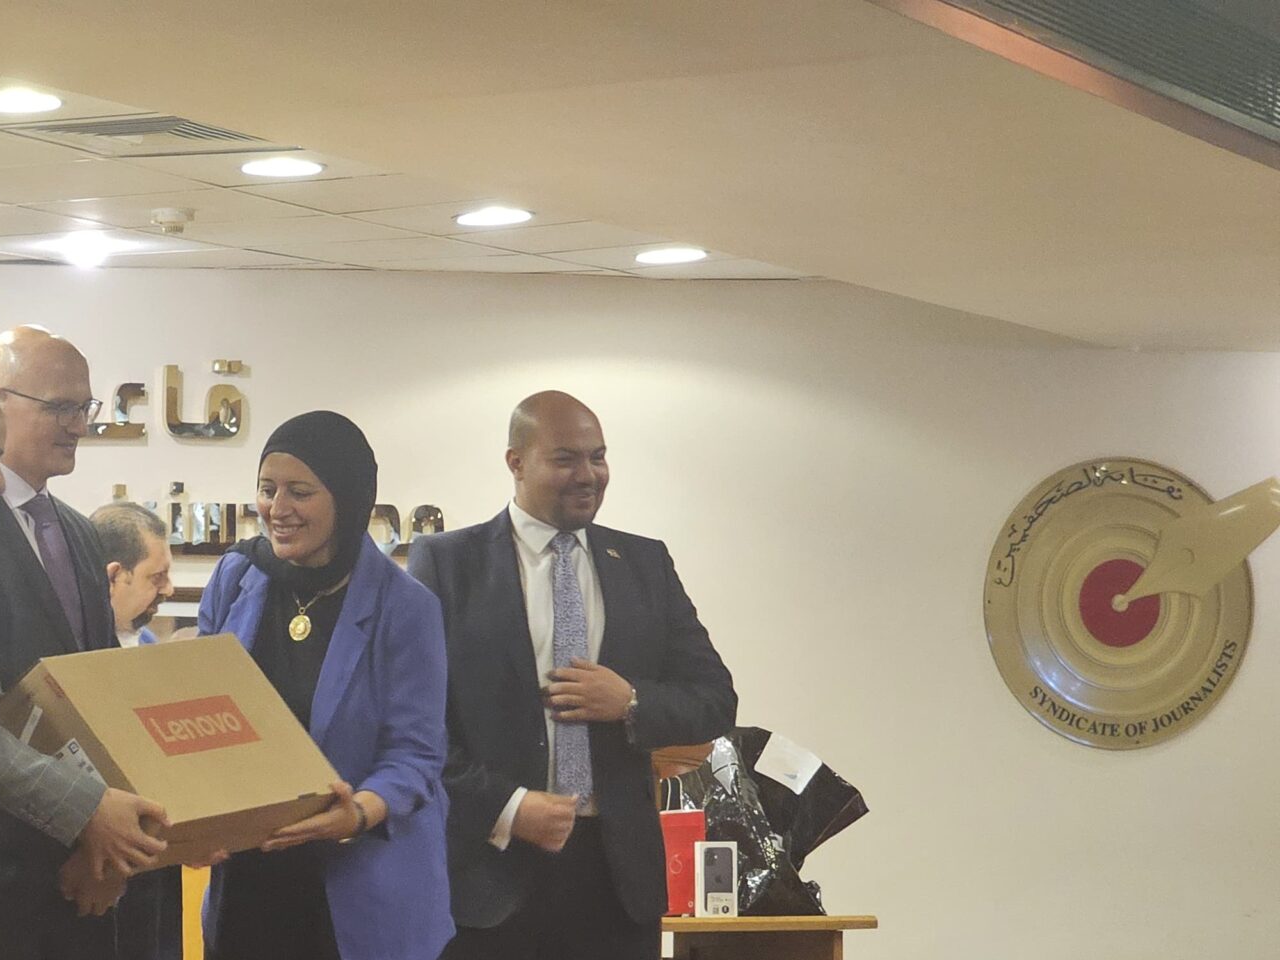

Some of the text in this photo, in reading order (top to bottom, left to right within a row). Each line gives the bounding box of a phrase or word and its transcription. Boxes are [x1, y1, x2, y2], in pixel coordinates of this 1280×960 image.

[88, 360, 244, 440] قاع
[148, 710, 242, 743] Lenovo
[1029, 639, 1238, 738] SYNDICATE OF JOURNALISTS
